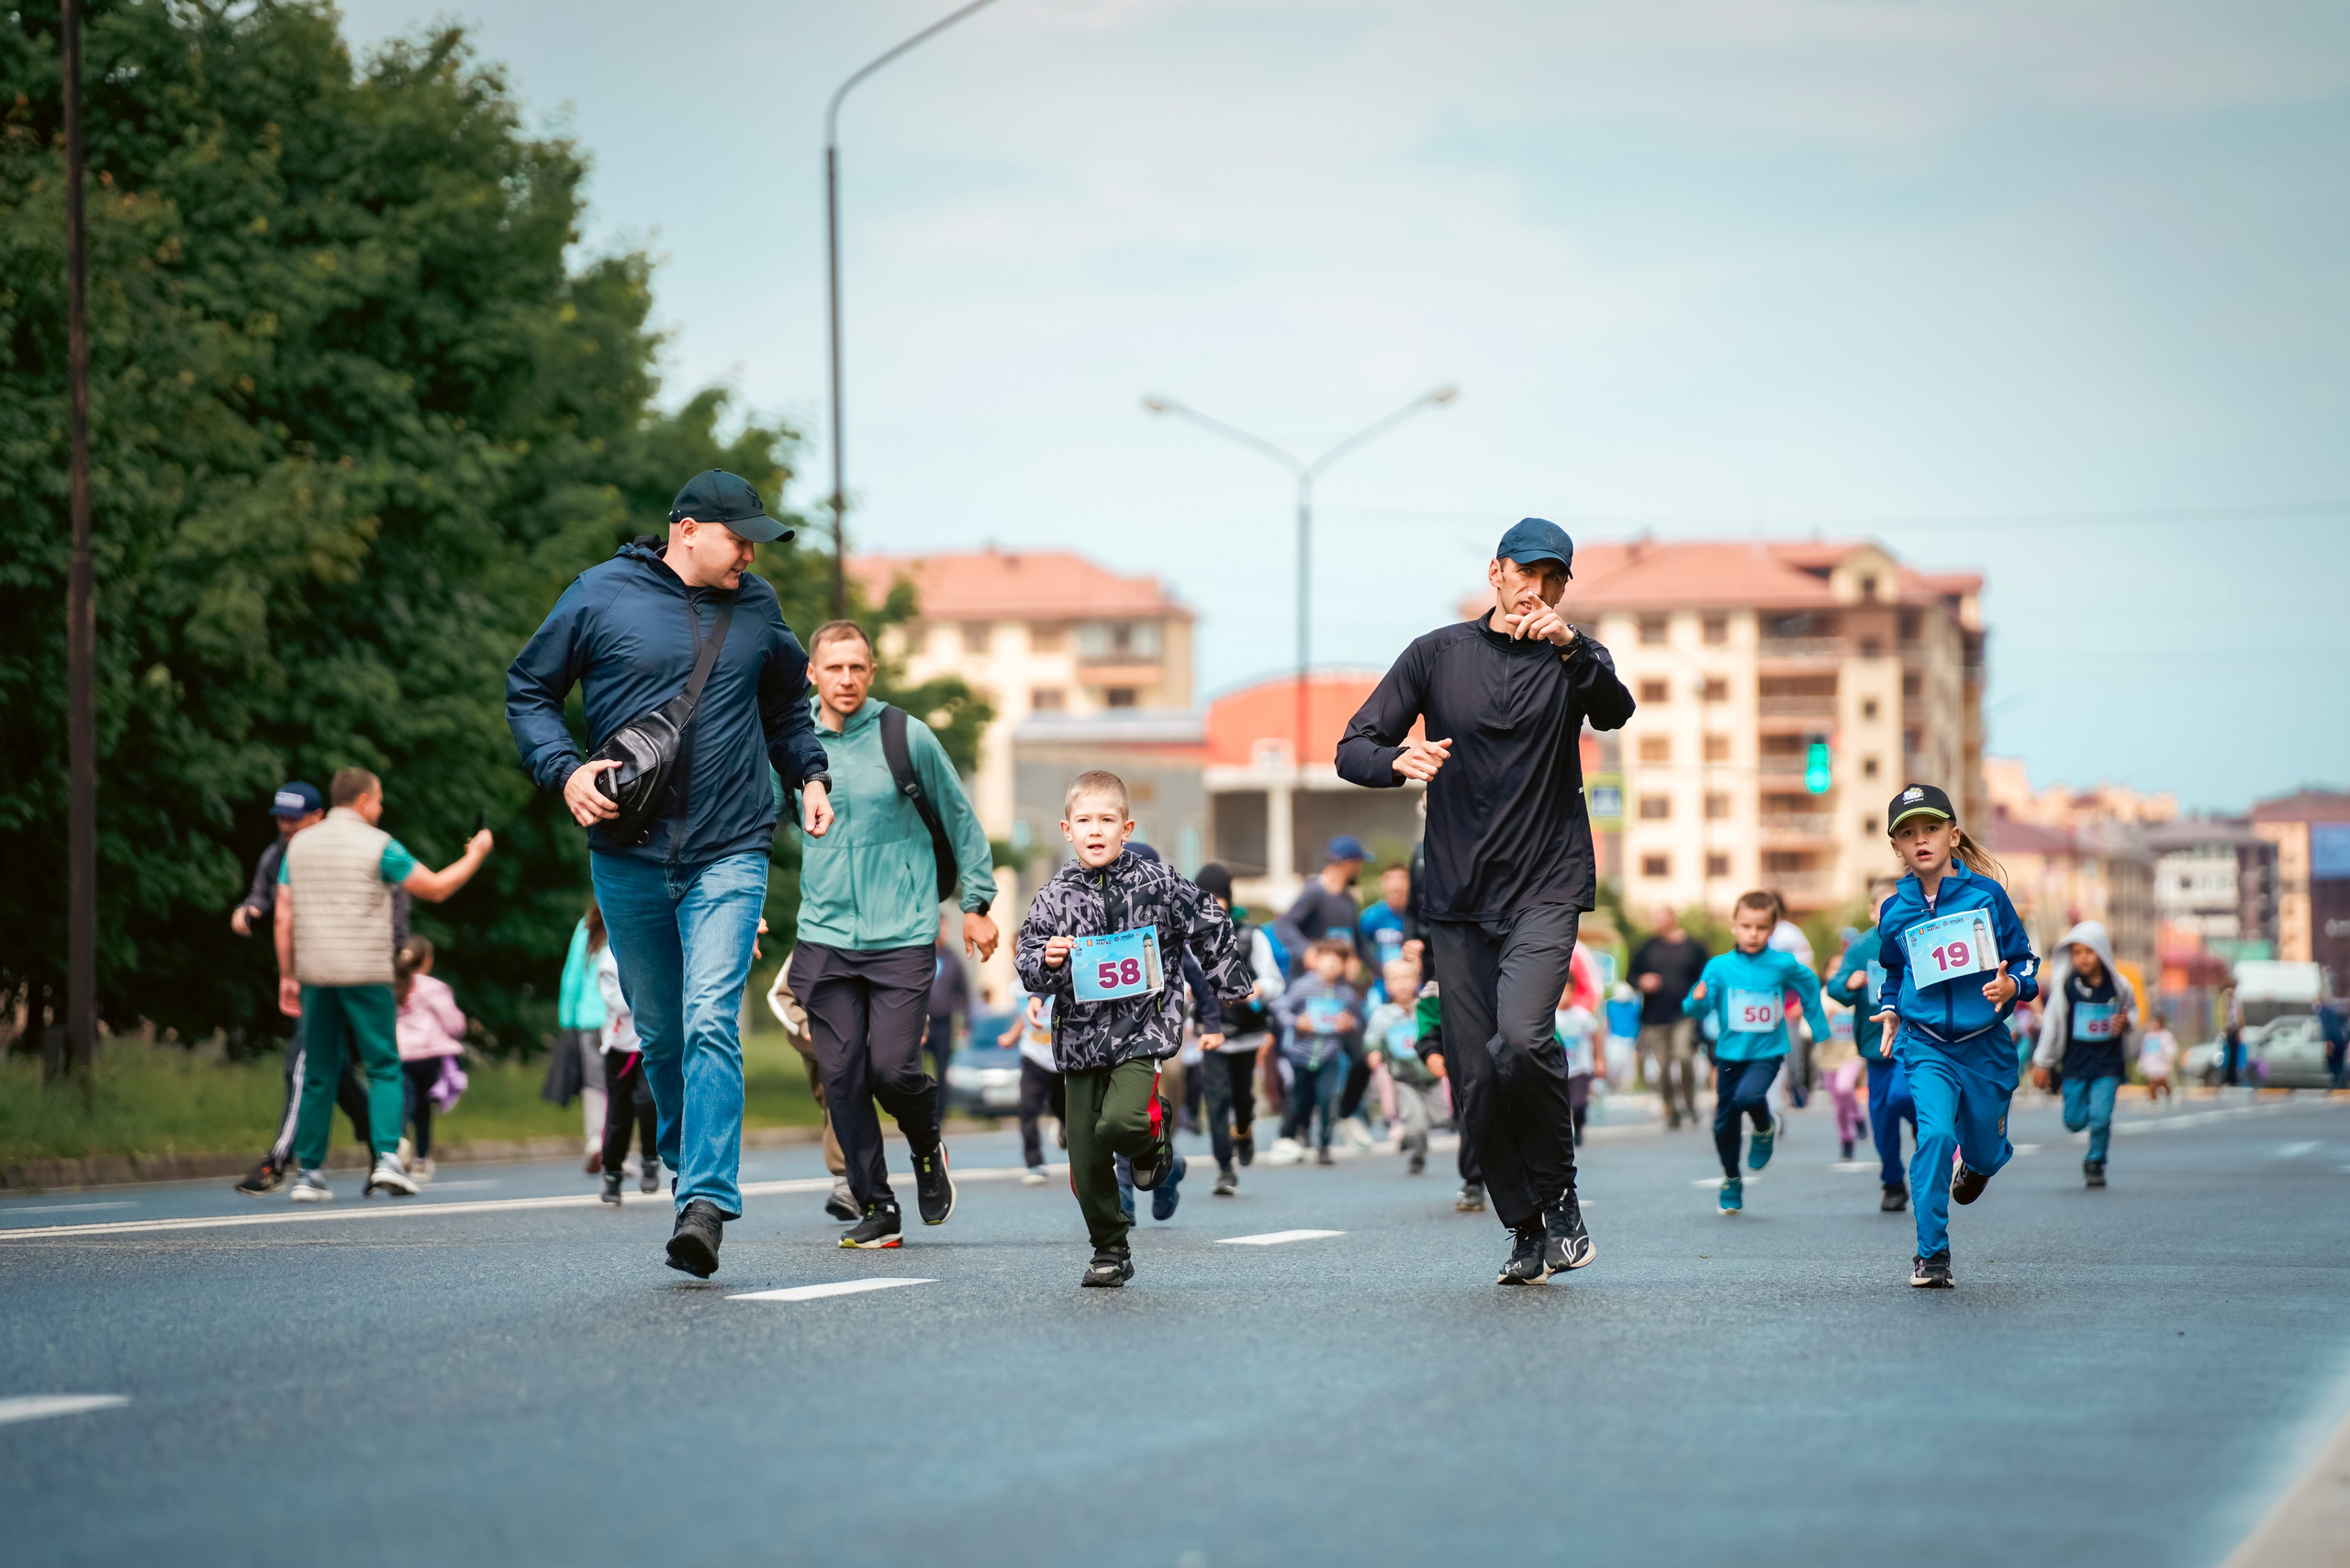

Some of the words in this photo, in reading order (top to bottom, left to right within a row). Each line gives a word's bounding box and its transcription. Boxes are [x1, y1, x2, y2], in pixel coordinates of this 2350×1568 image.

[1931, 941, 1970, 971] 19
[1098, 958, 1141, 989] 58
[1744, 1005, 1771, 1023] 50
